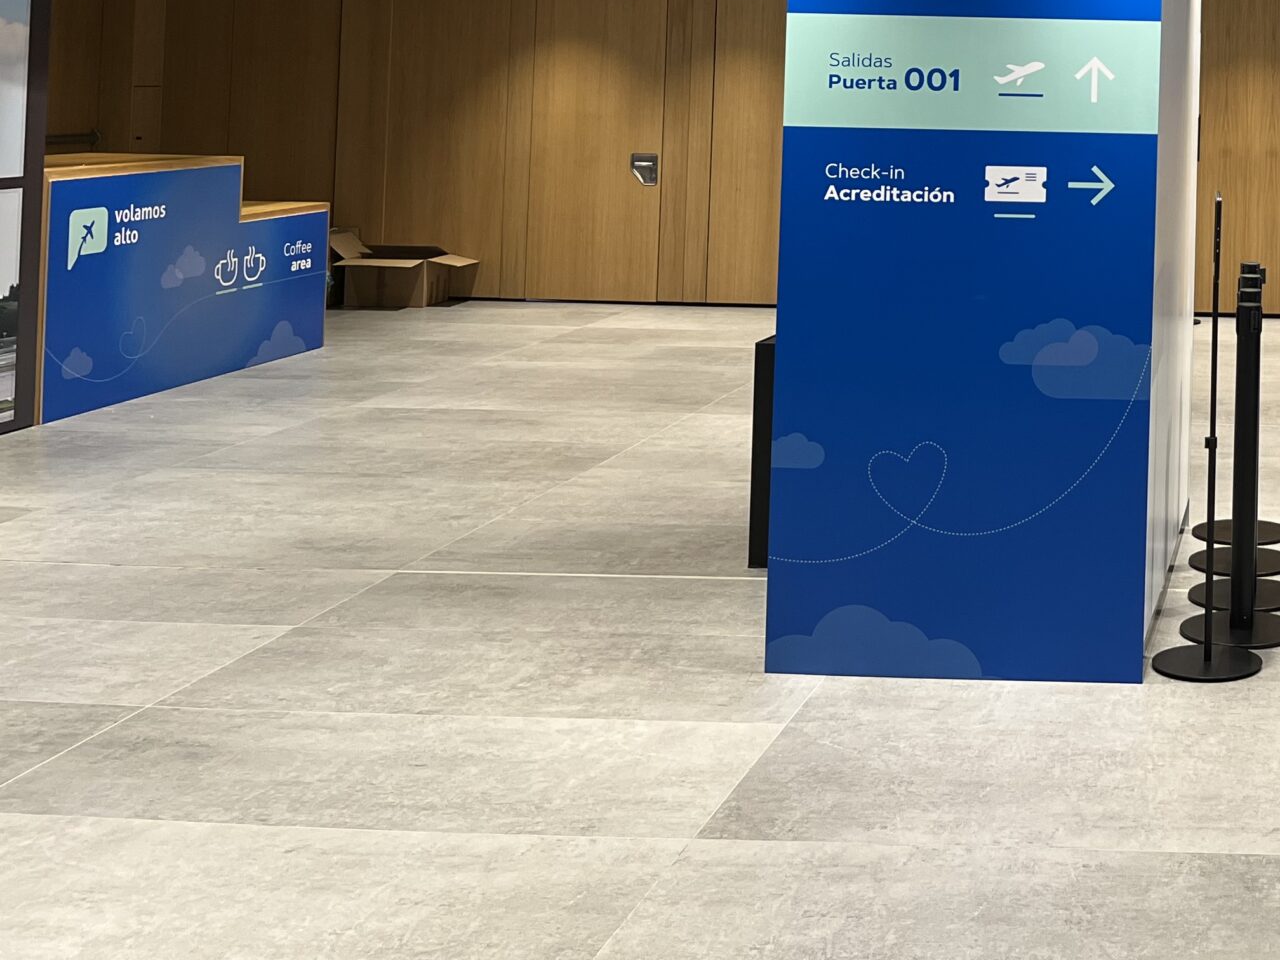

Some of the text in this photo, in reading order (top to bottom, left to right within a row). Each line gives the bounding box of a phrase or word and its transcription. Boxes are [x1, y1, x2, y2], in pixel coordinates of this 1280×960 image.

[829, 52, 892, 68] Salidas
[828, 67, 960, 91] Puerta 001
[825, 163, 905, 179] Check-in
[824, 185, 955, 203] Acreditación
[115, 204, 166, 223] volamos
[114, 228, 138, 246] alto
[283, 240, 312, 257] Coffee
[291, 258, 312, 271] area
